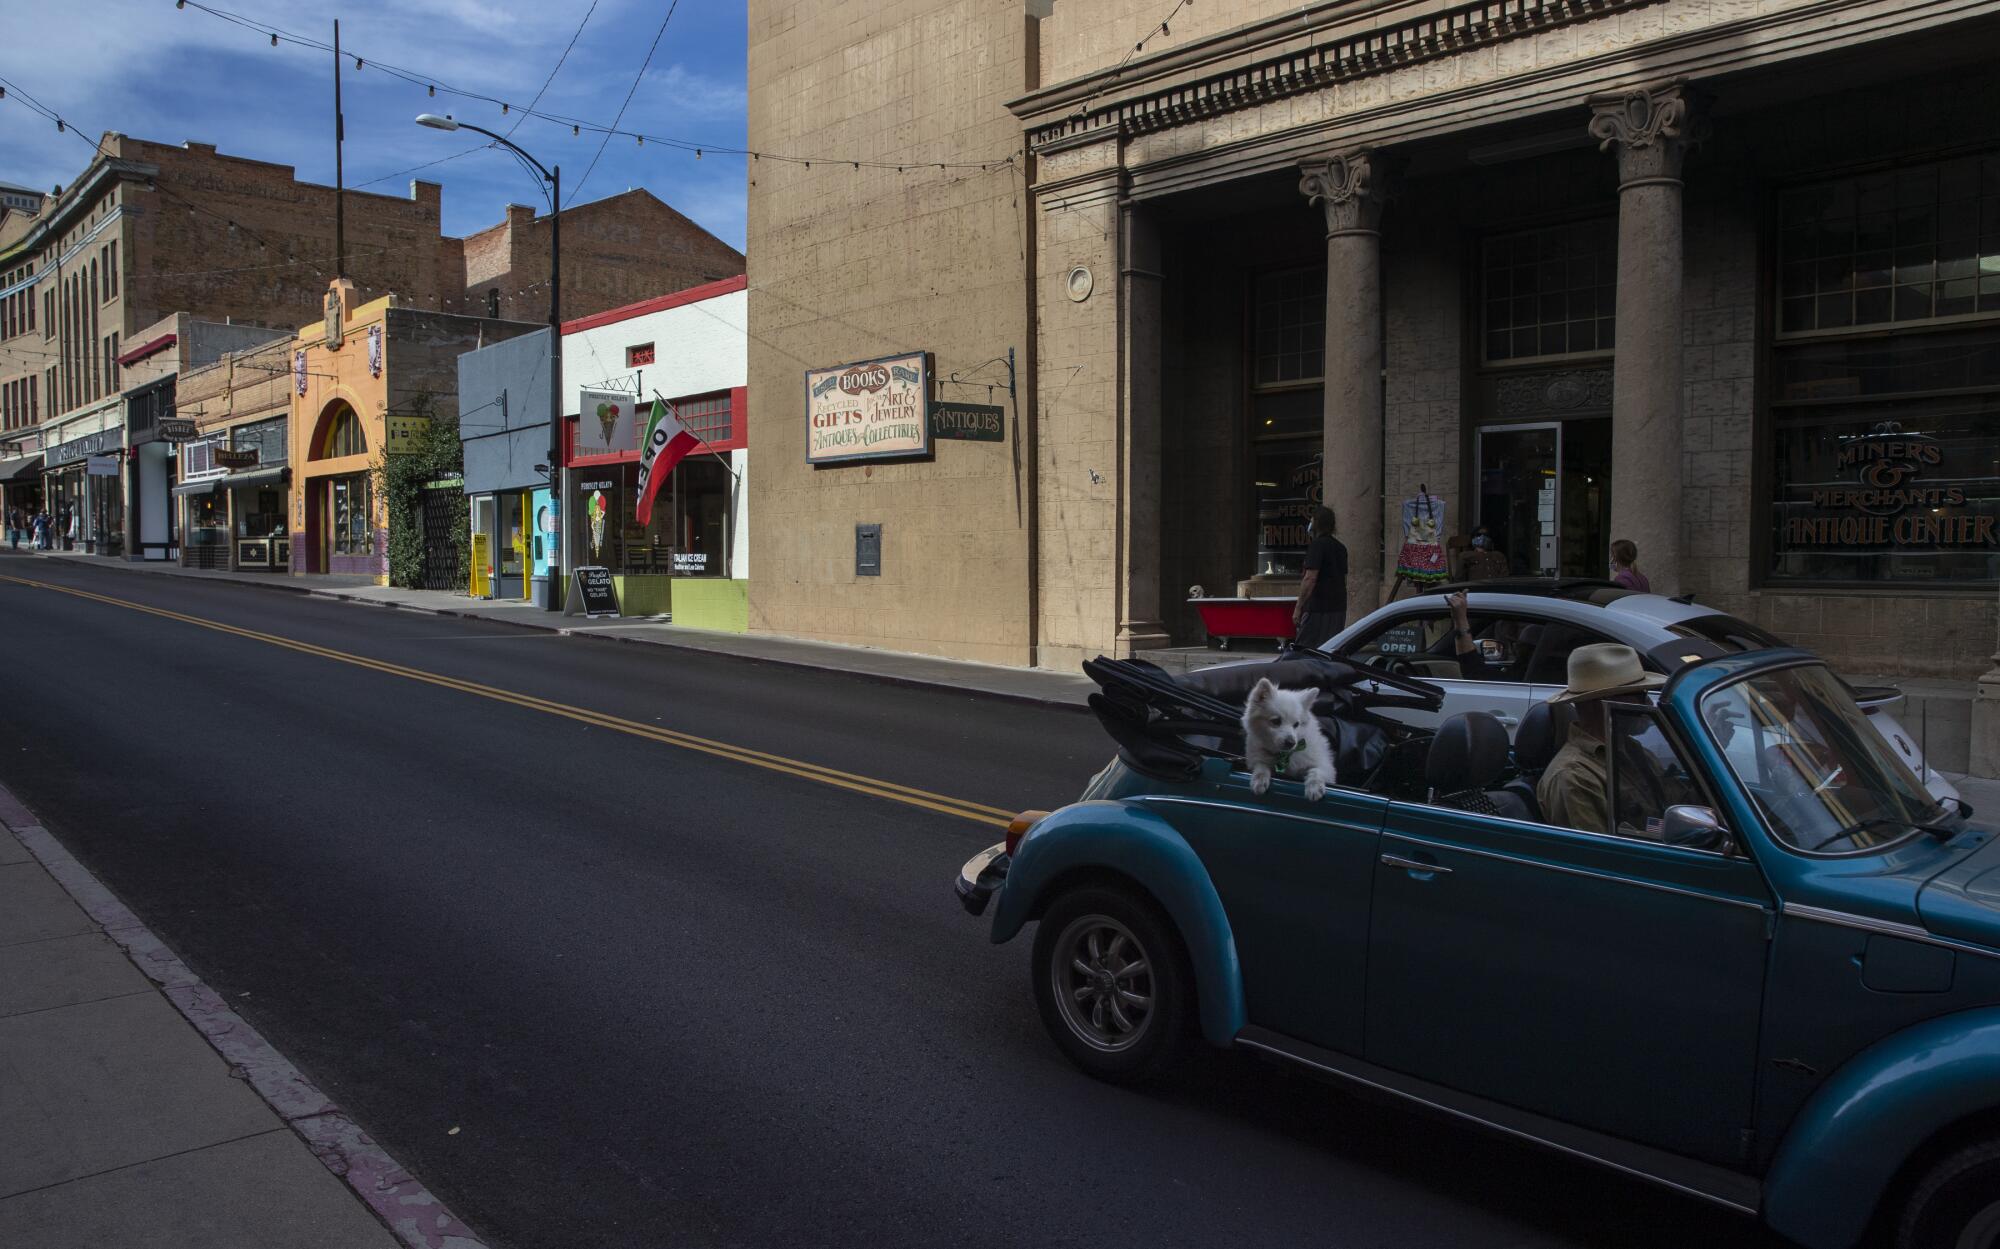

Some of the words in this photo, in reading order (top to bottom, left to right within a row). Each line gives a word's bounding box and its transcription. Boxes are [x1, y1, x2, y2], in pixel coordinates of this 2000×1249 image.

[843, 369, 886, 390] BOOKS
[881, 385, 904, 407] ART
[905, 387, 920, 405] &
[813, 409, 863, 428] GIFTS
[871, 402, 916, 423] JEWELRY
[933, 407, 1000, 433] ANTIQUES
[814, 430, 857, 451] ANTIQUES
[864, 424, 920, 447] COLLECTIBLES
[1837, 441, 1943, 470] MINERS
[1292, 468, 1321, 488] MIN
[1862, 459, 1918, 488] &
[1811, 487, 1967, 508] MERCHANTS
[1786, 515, 1890, 545] ANTIQUE
[1893, 514, 1997, 545] CENTER
[1381, 643, 1417, 654] OPEN
